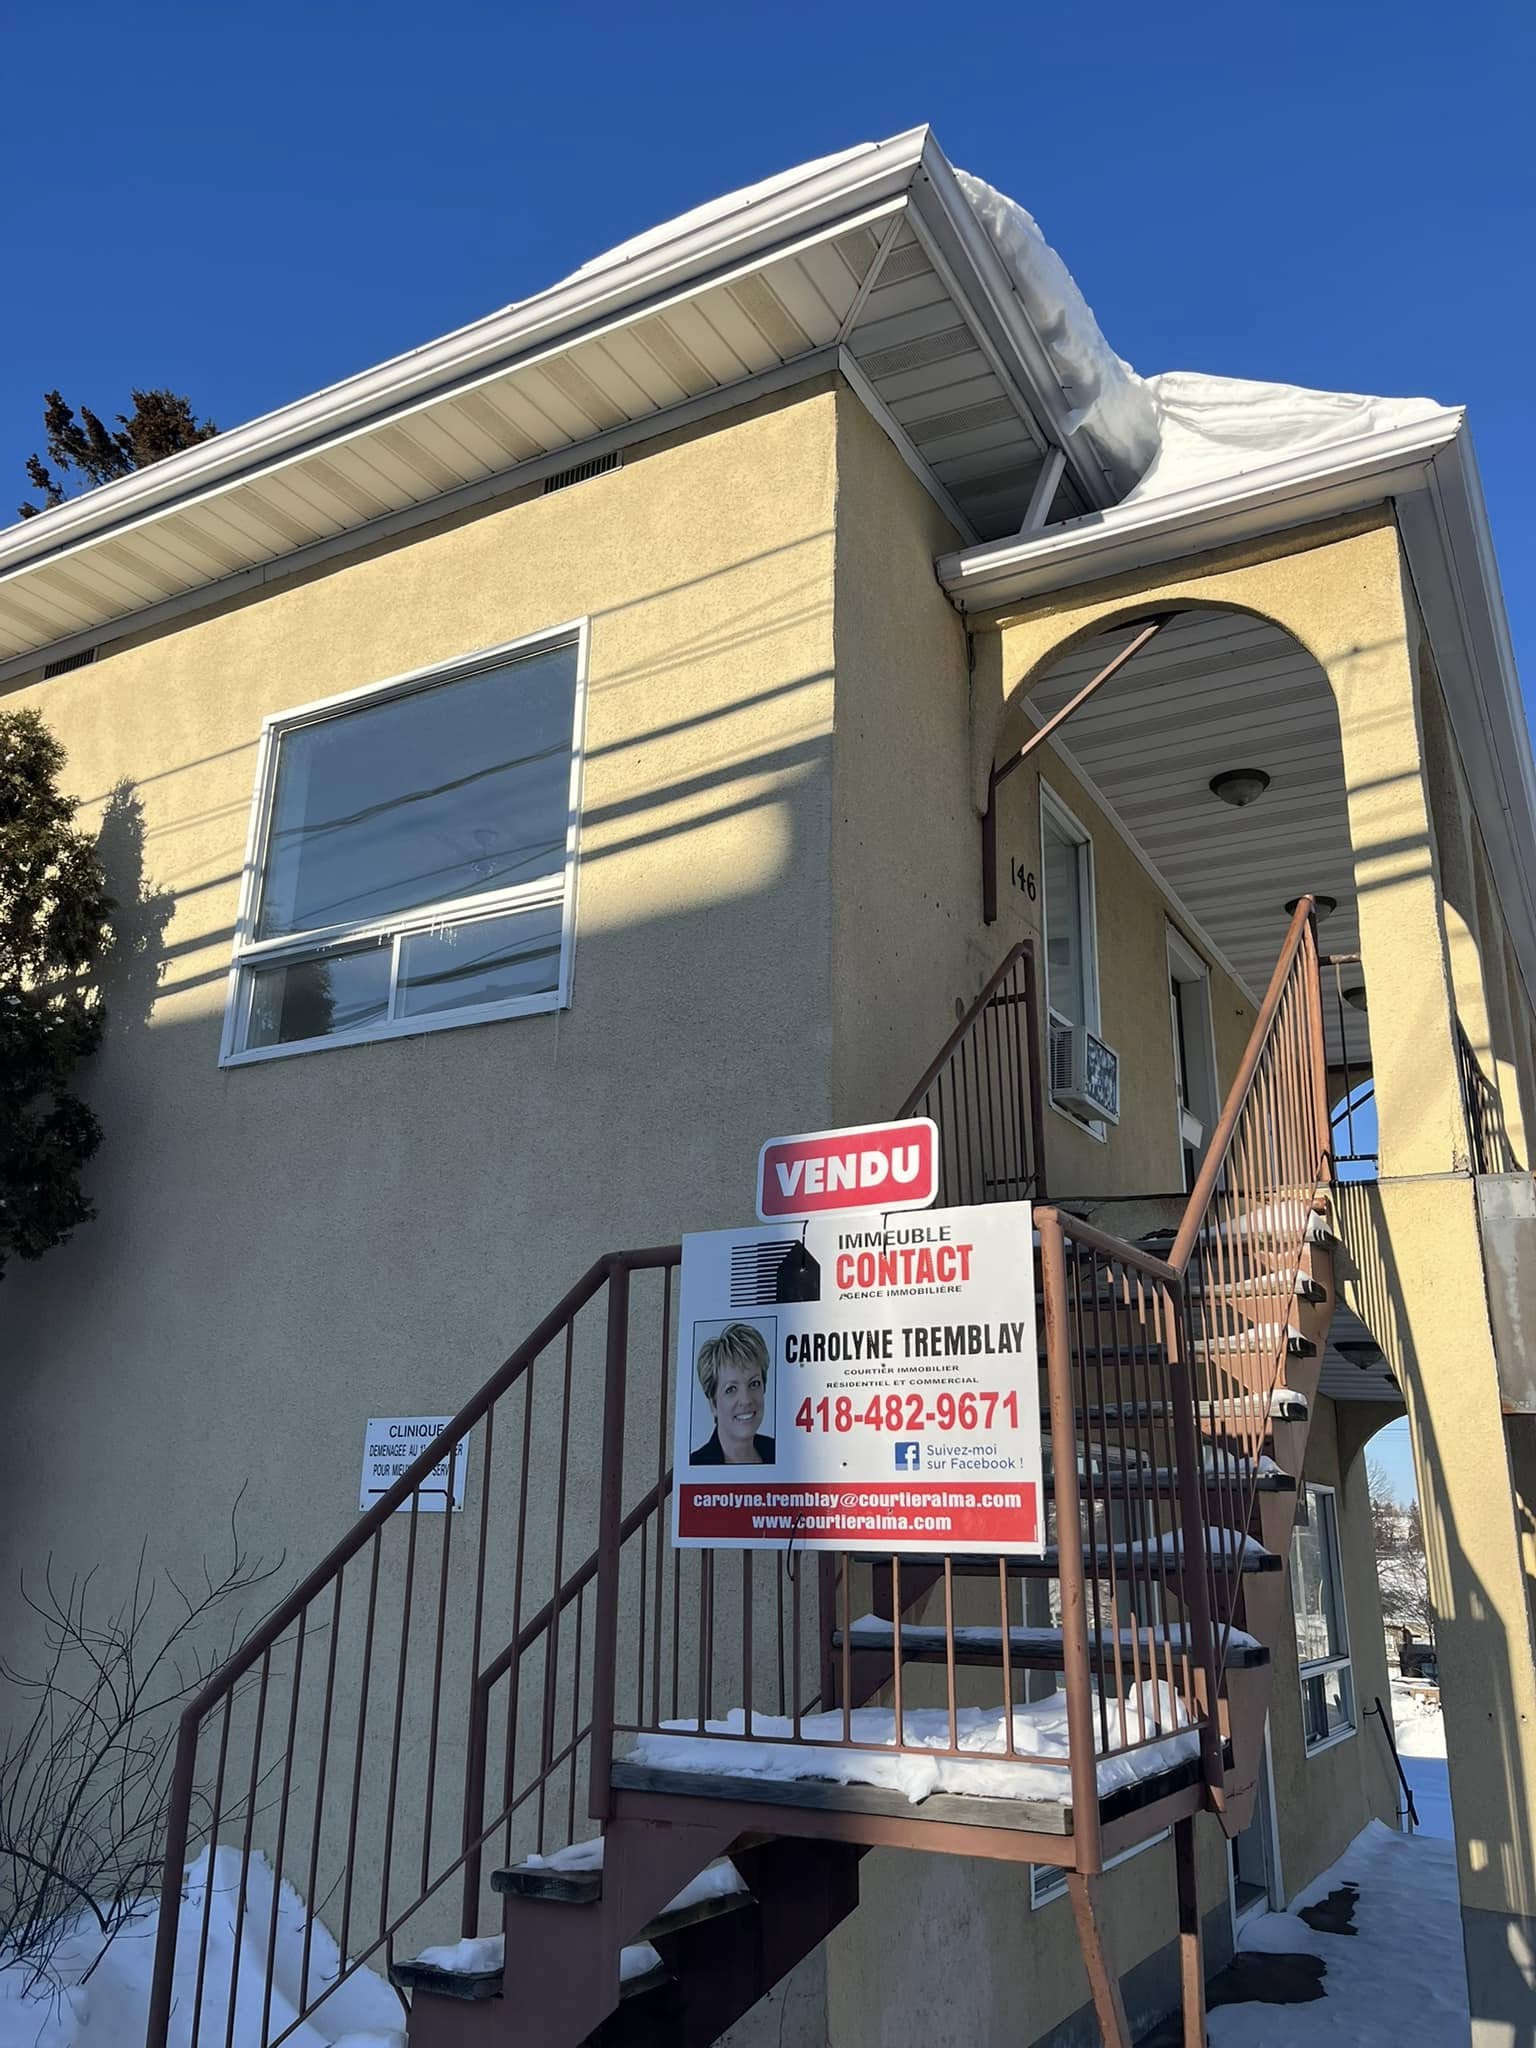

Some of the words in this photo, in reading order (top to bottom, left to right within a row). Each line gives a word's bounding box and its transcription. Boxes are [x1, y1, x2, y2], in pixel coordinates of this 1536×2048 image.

[1010, 857, 1036, 902] 146
[775, 1144, 921, 1198] VENDU
[838, 1226, 952, 1251] IMMEUBLE
[836, 1244, 974, 1290] CONTACT
[838, 1289, 884, 1301] AGENCE
[784, 1328, 894, 1364] CAROLYNE
[902, 1322, 1026, 1358] TREMBLAY
[843, 1366, 894, 1376] COURTIER
[896, 1364, 960, 1374] IMMOBILIER
[893, 1379, 906, 1388] ET
[908, 1376, 980, 1386] COMMERCIAL
[795, 1390, 1019, 1433] 418-482-9671
[389, 1423, 445, 1438] CLINIQUE
[408, 1444, 418, 1457] AU
[926, 1443, 998, 1457] Suivez-moi
[373, 1464, 390, 1477] POUR
[926, 1459, 947, 1470] sur
[950, 1457, 1016, 1470] Facebook
[693, 1490, 1022, 1510] carolyne.tremblay@courtieralma.com
[752, 1512, 952, 1531] www.courtieralma.com
